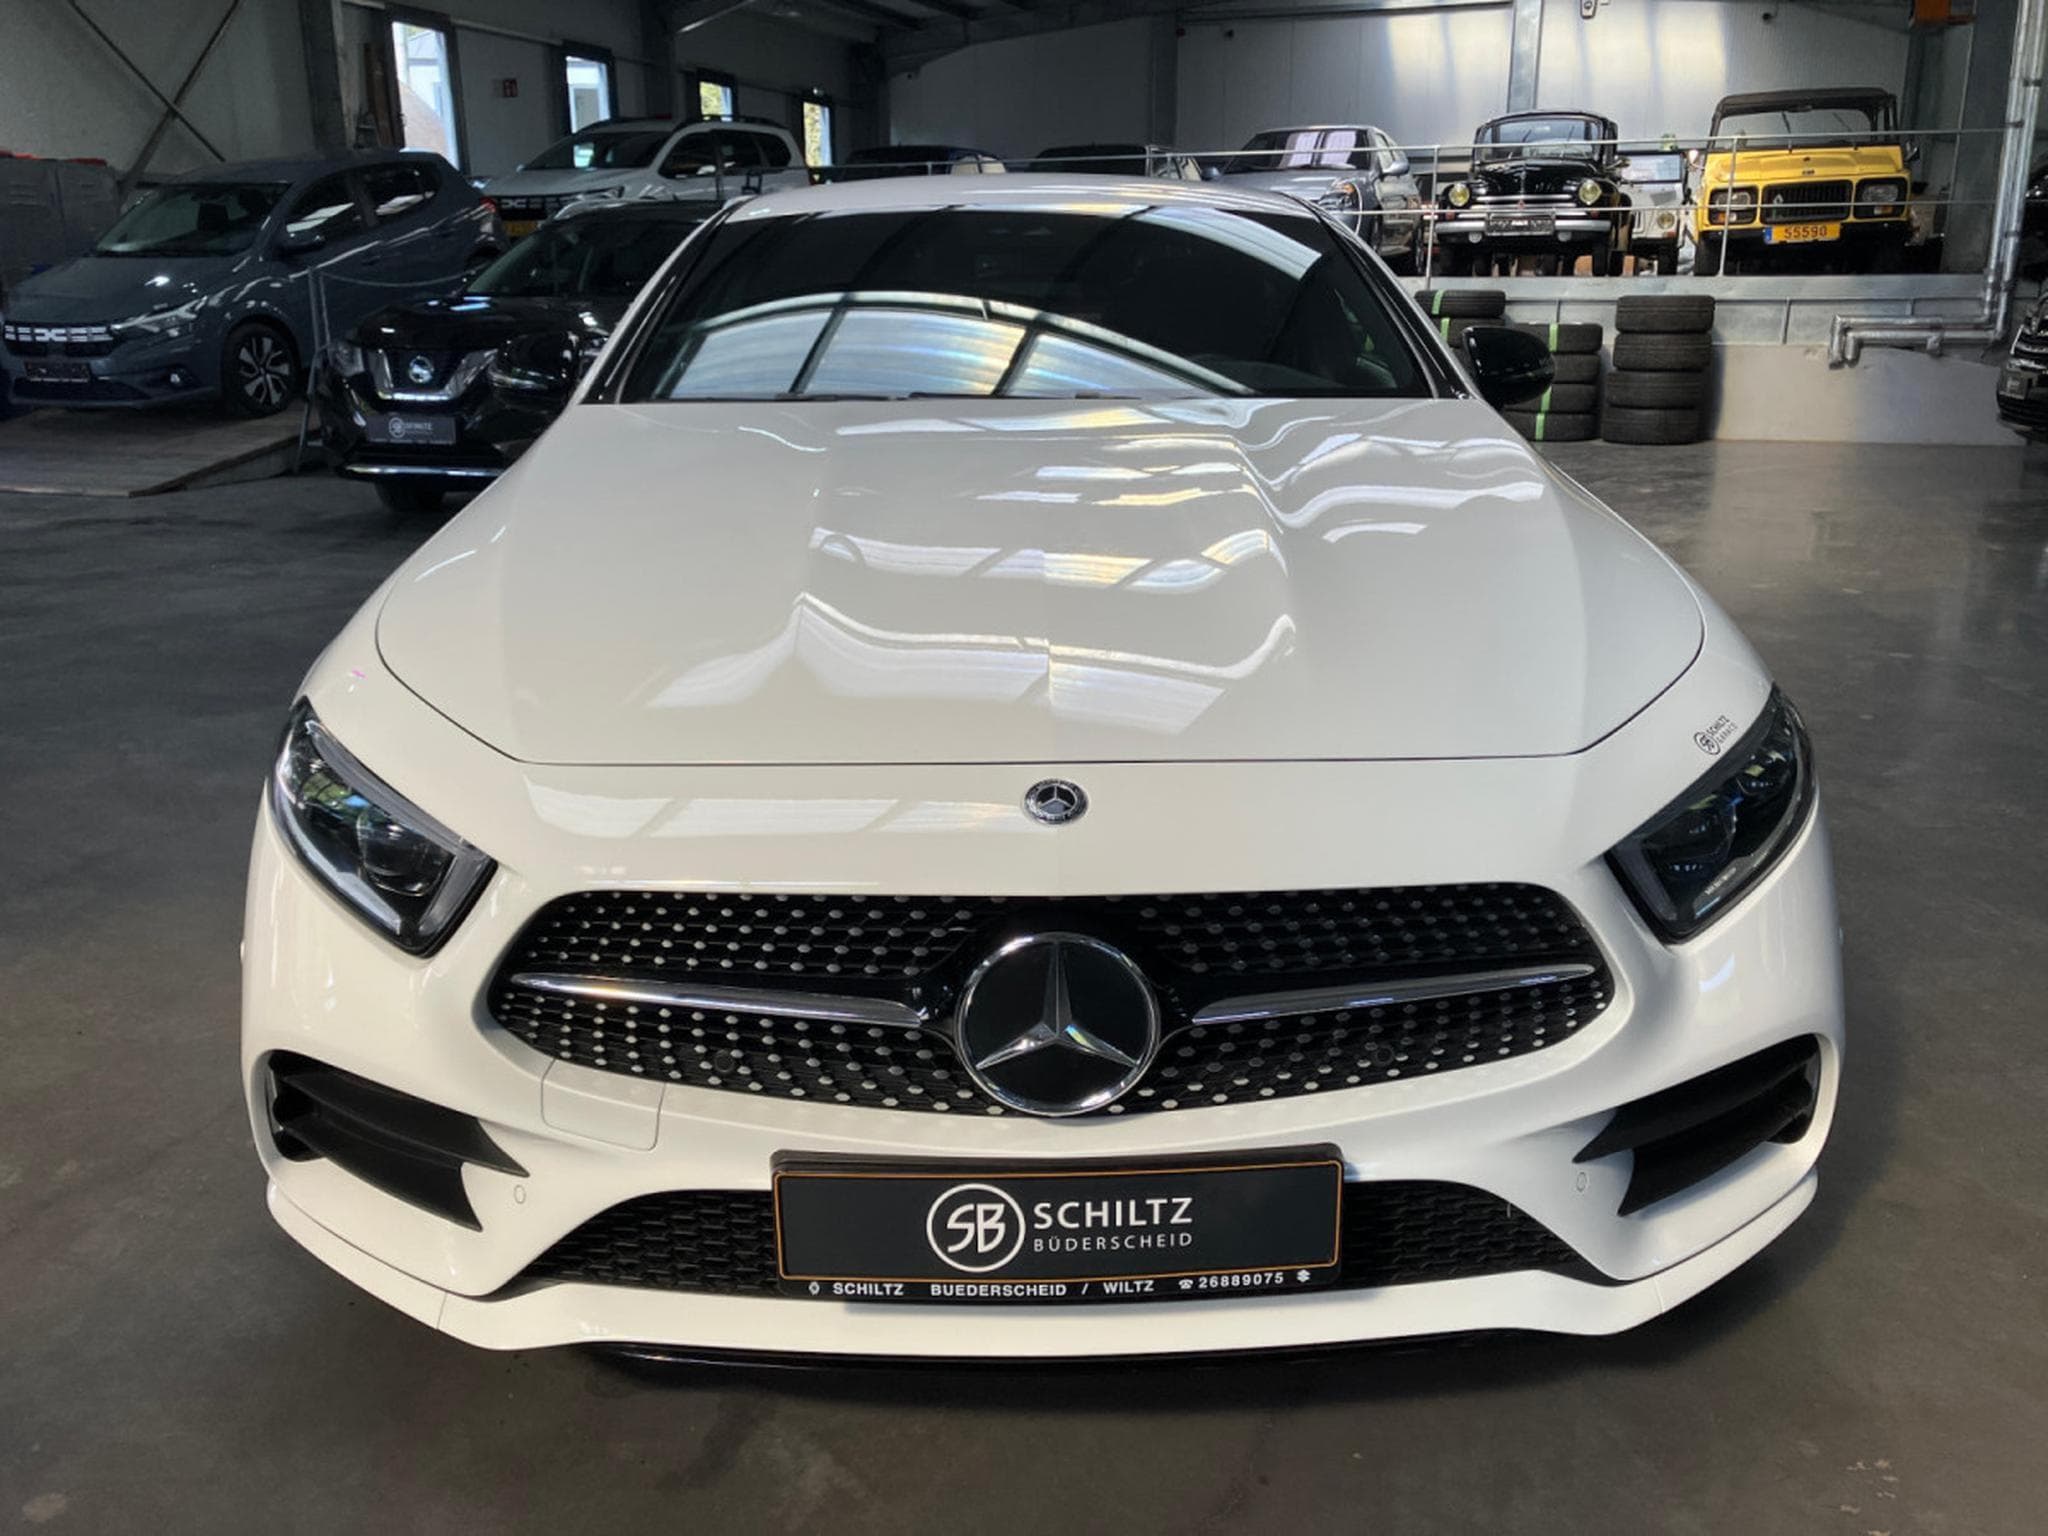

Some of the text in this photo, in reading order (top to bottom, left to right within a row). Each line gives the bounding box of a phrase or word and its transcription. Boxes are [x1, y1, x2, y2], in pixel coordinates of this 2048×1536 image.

[1784, 225, 1827, 239] 55590
[1033, 1197, 1193, 1230] SCHILTZ
[947, 1203, 1006, 1254] SB
[1033, 1232, 1193, 1253] BÜDERSCHEID
[833, 1282, 904, 1296] SCHILTZ
[930, 1284, 1067, 1297] BUEDERSCHEID
[1104, 1279, 1154, 1295] WILTZ
[1199, 1272, 1284, 1289] 26889075
